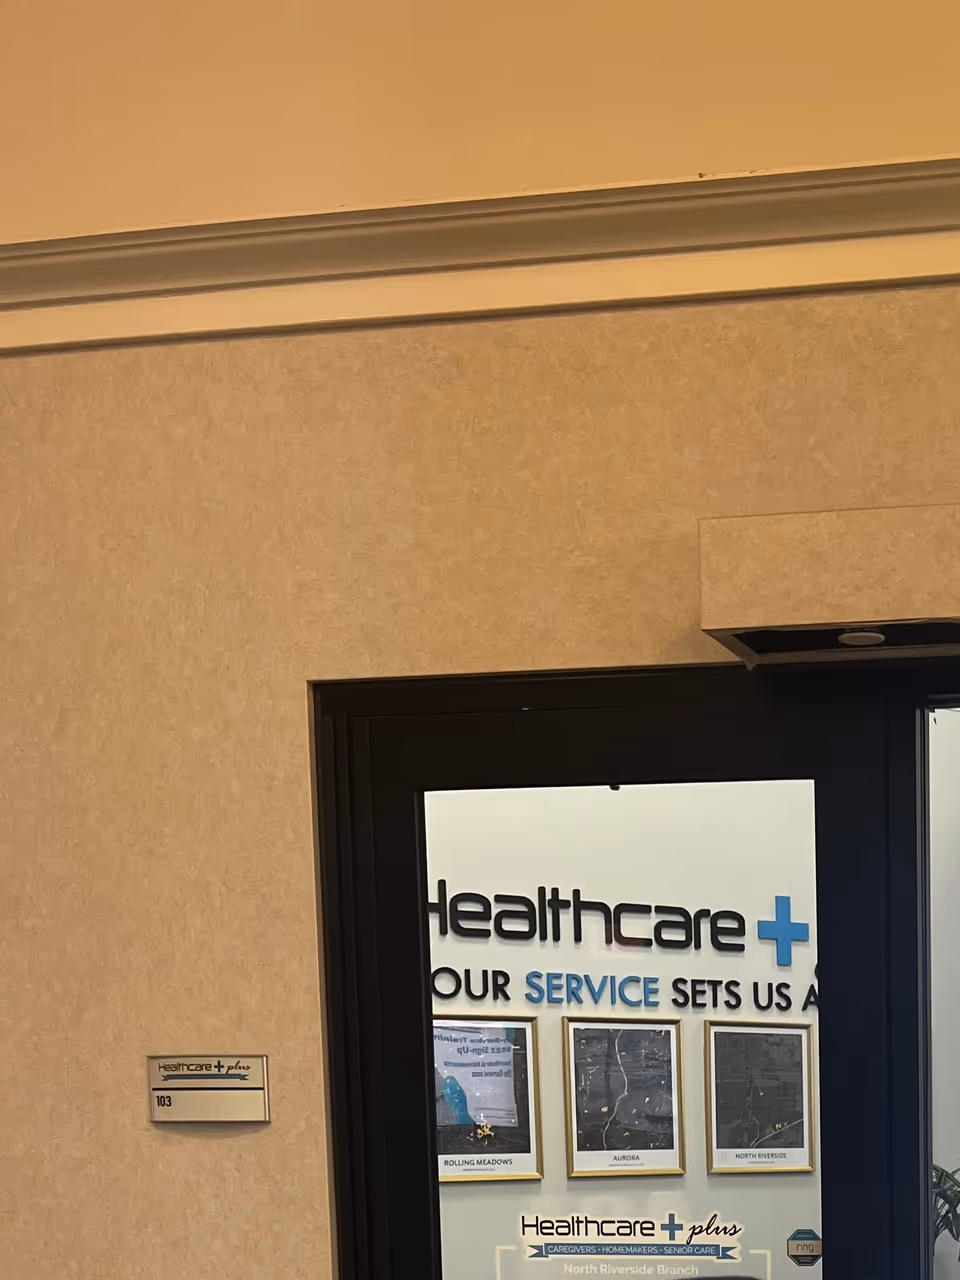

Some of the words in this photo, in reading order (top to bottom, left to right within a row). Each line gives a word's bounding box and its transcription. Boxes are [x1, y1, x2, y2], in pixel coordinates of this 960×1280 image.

[431, 967, 511, 1001] OUR
[525, 970, 660, 1007] SERVICE
[671, 977, 742, 1010] SETS
[753, 982, 792, 1011] US
[158, 1062, 212, 1072] Healthcare
[225, 1060, 252, 1074] plus
[156, 1095, 172, 1107] 103
[521, 1215, 655, 1236] Healthcare
[685, 1213, 742, 1245] plus
[548, 1246, 596, 1254] CAREGIVERS
[602, 1246, 658, 1254] HOMEMAKERS
[664, 1246, 693, 1254] SENIOR
[694, 1247, 716, 1255] CARE
[564, 1264, 597, 1275] North
[600, 1264, 653, 1275] Riverside
[657, 1265, 698, 1276] Branch
